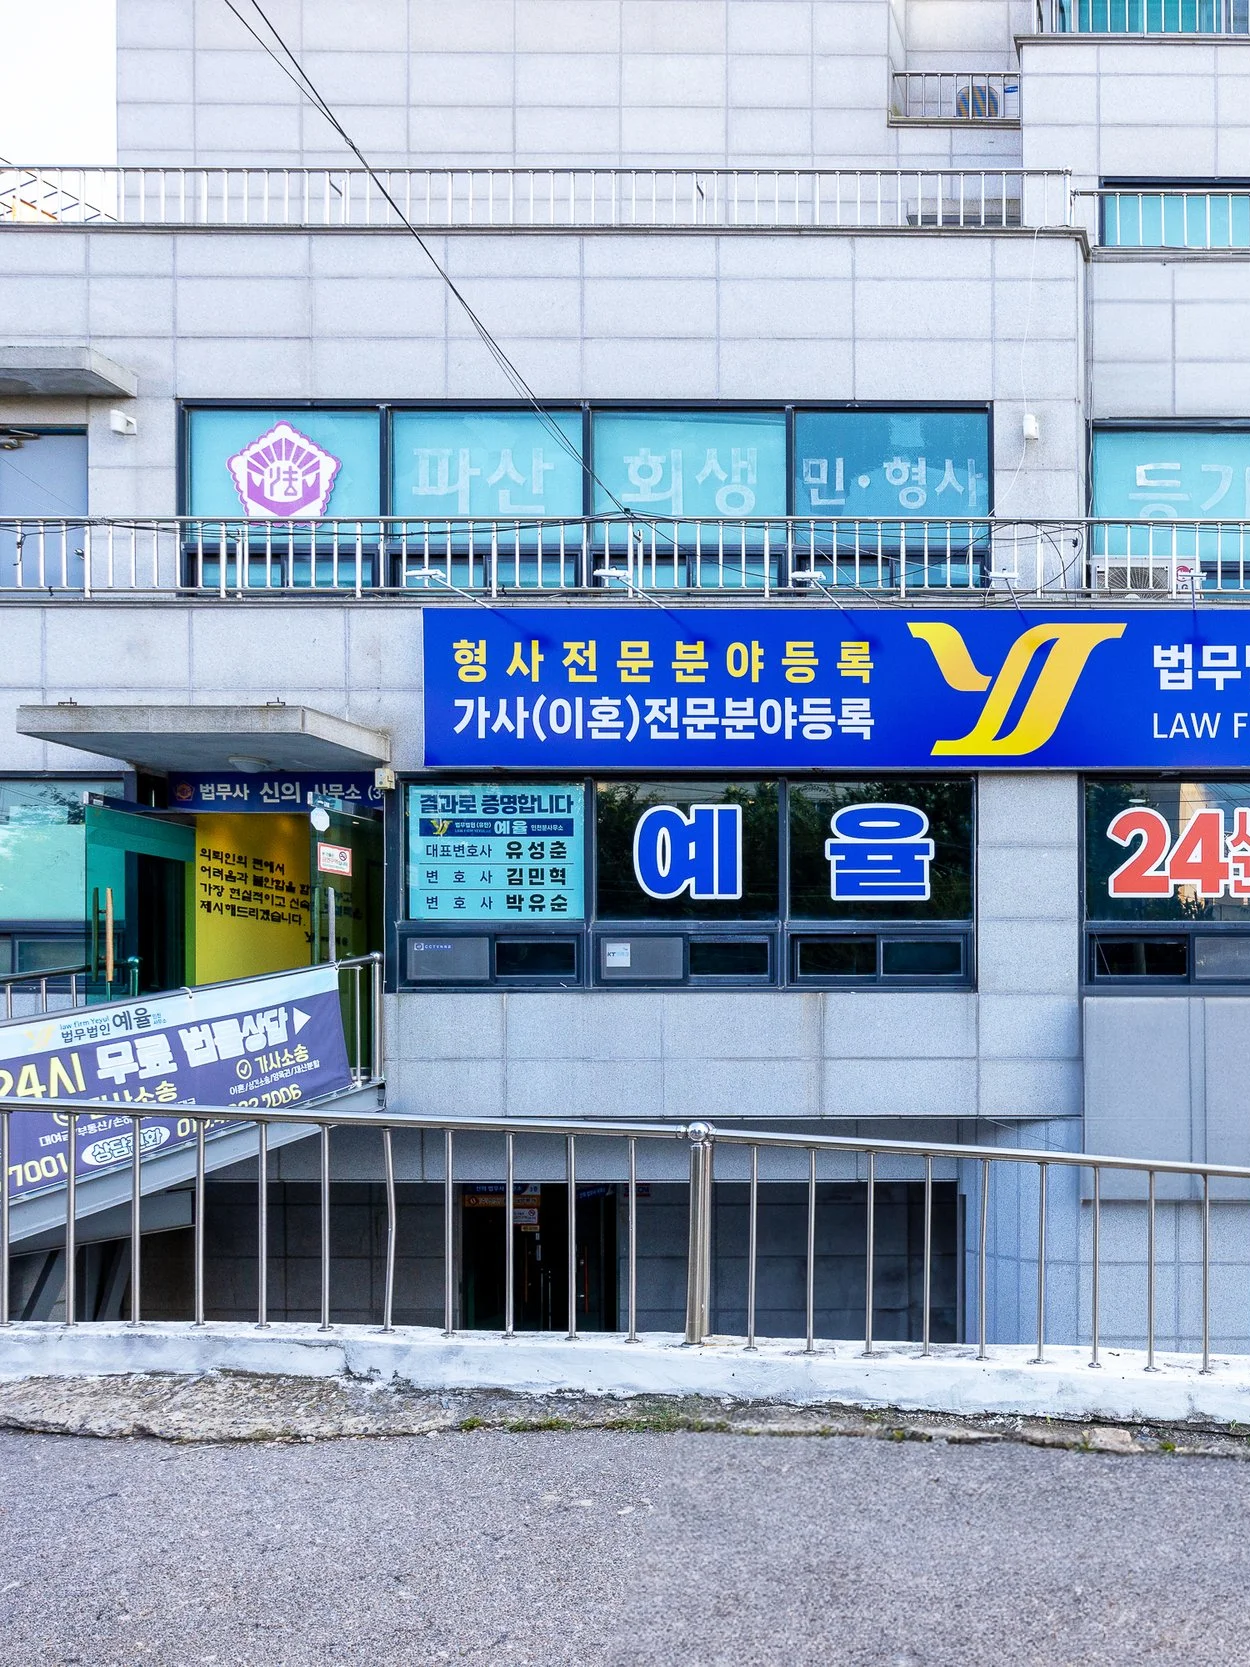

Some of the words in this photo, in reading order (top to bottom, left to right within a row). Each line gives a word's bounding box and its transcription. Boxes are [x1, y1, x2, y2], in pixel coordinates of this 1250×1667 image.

[412, 448, 554, 515] 파산
[621, 448, 757, 516] 회생
[452, 696, 875, 742] 가사(이혼)전문분야등록
[1153, 712, 1220, 739] LAW
[200, 783, 249, 801] 법무사
[260, 782, 301, 803] 신의
[420, 794, 477, 814] 결과로
[481, 793, 574, 814] 증명합니다
[494, 820, 528, 834] 예율
[200, 848, 248, 868] 의뢰인의
[252, 858, 285, 875] 편에서
[426, 845, 492, 858] 대표변호사
[506, 841, 567, 860] 유성춘
[200, 866, 248, 885] 어려움과
[253, 875, 296, 893] 불안함을
[506, 867, 566, 886] 김민혁
[200, 883, 225, 897] 가장
[229, 887, 286, 907] 현실적이고
[506, 894, 568, 912] 박유순
[61, 1023, 111, 1043] 법무법인
[112, 1007, 151, 1031] 예율
[96, 1033, 178, 1085] 무료
[178, 1006, 288, 1068] 법률상담
[255, 1044, 309, 1074] 가사소송
